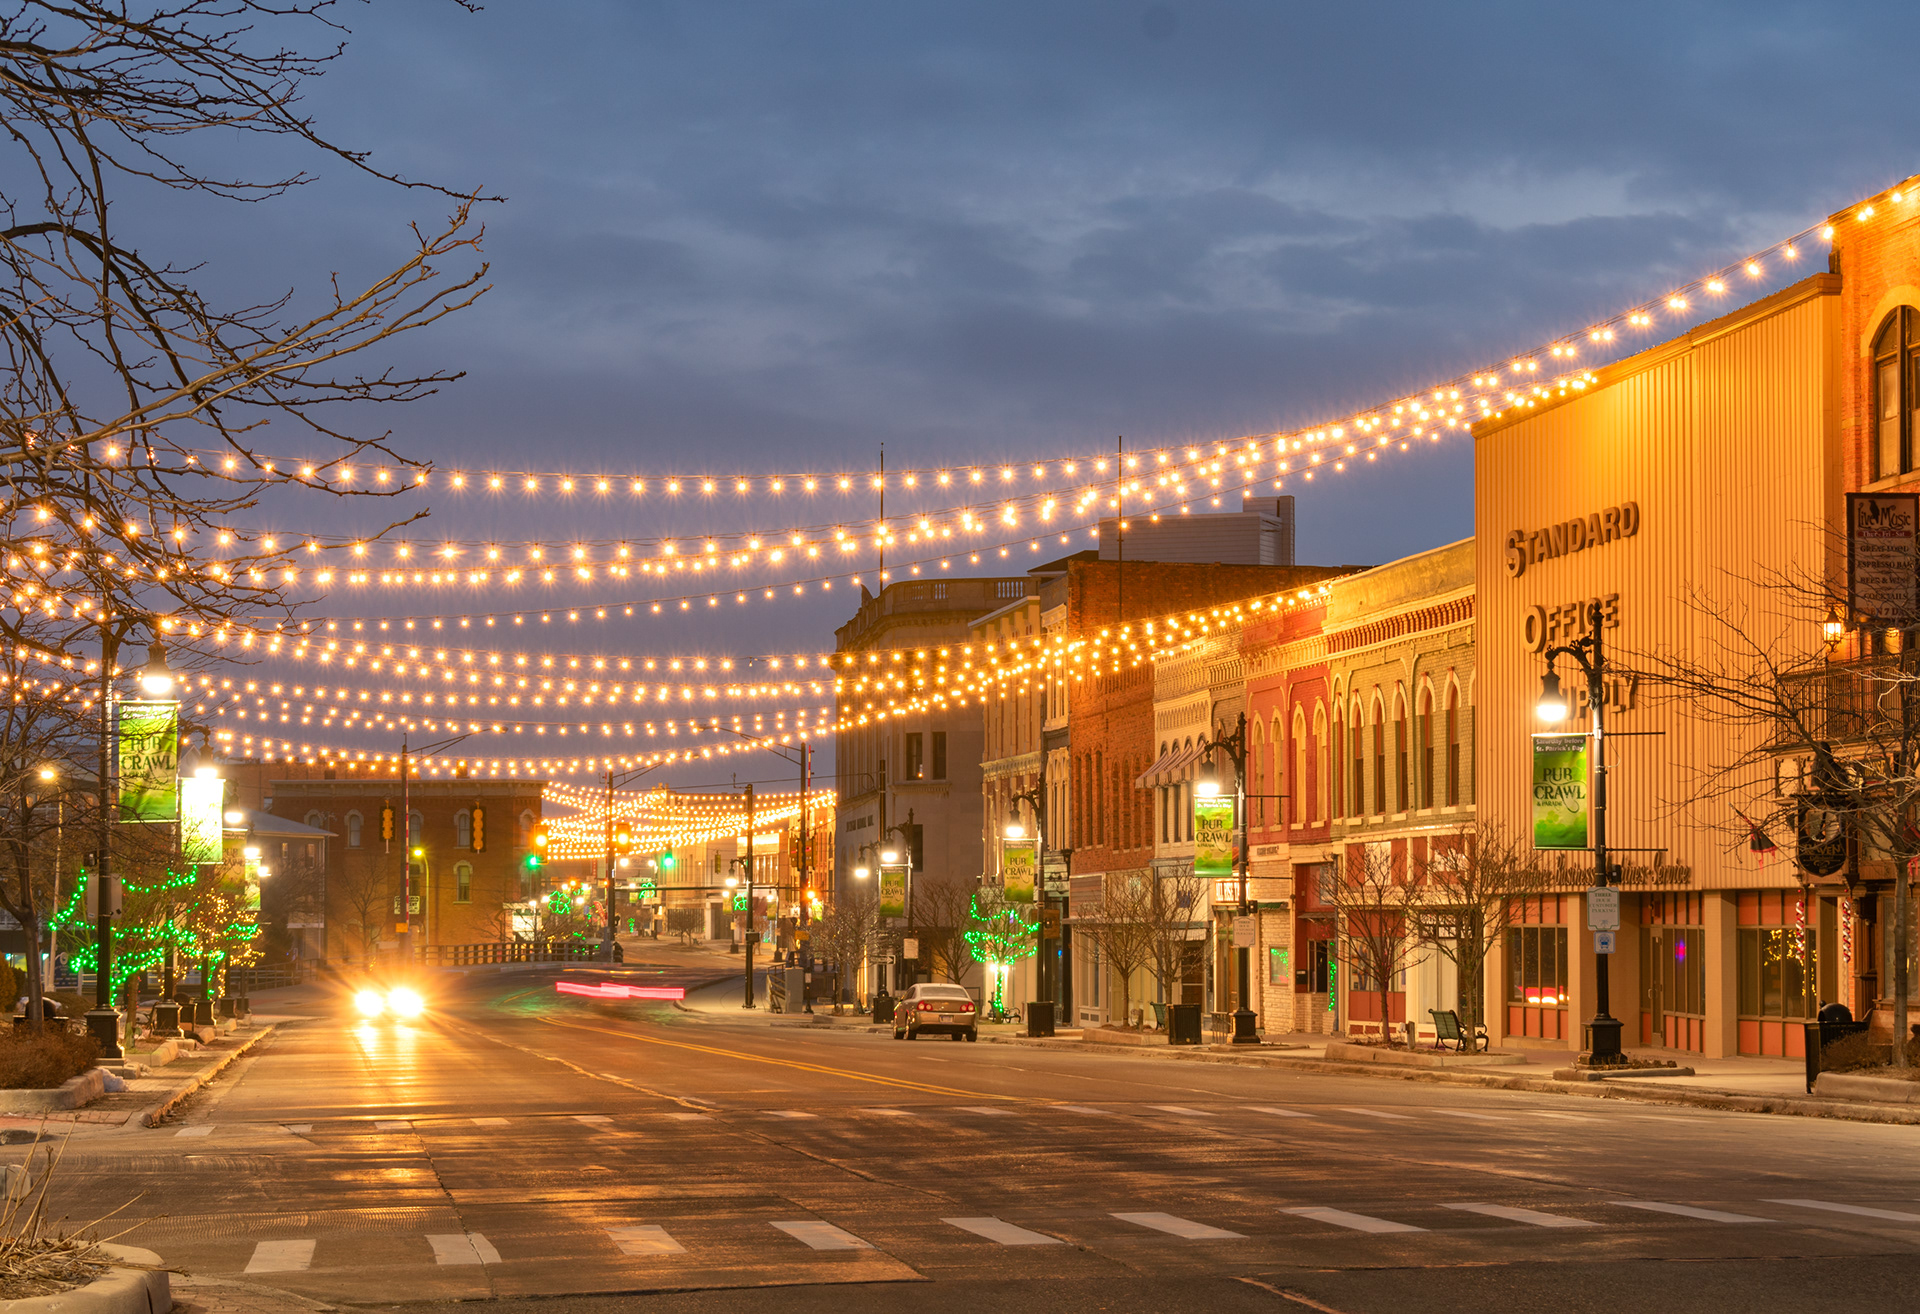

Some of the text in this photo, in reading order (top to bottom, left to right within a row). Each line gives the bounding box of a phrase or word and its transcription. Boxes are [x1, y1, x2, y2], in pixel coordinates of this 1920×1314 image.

[1857, 502, 1911, 529] Live Music
[1504, 501, 1640, 578] STANDARD
[1857, 560, 1895, 568] ESPRESSO
[1523, 593, 1619, 653] OFFICE
[1546, 674, 1640, 729] UPLY
[131, 736, 162, 752] PUB
[1536, 738, 1563, 746] Saturday
[1545, 744, 1571, 752] Patrick's
[1572, 745, 1584, 753] Day
[121, 755, 175, 771] CRAWL
[1543, 767, 1573, 783] PUB
[1534, 785, 1586, 802] CRAWL
[1202, 819, 1223, 831] PUB
[1196, 831, 1232, 843] CRAWL
[1010, 857, 1027, 866] PUB
[1555, 854, 1595, 885] Business
[1652, 851, 1691, 885] Service
[1005, 867, 1033, 876] CRAWL
